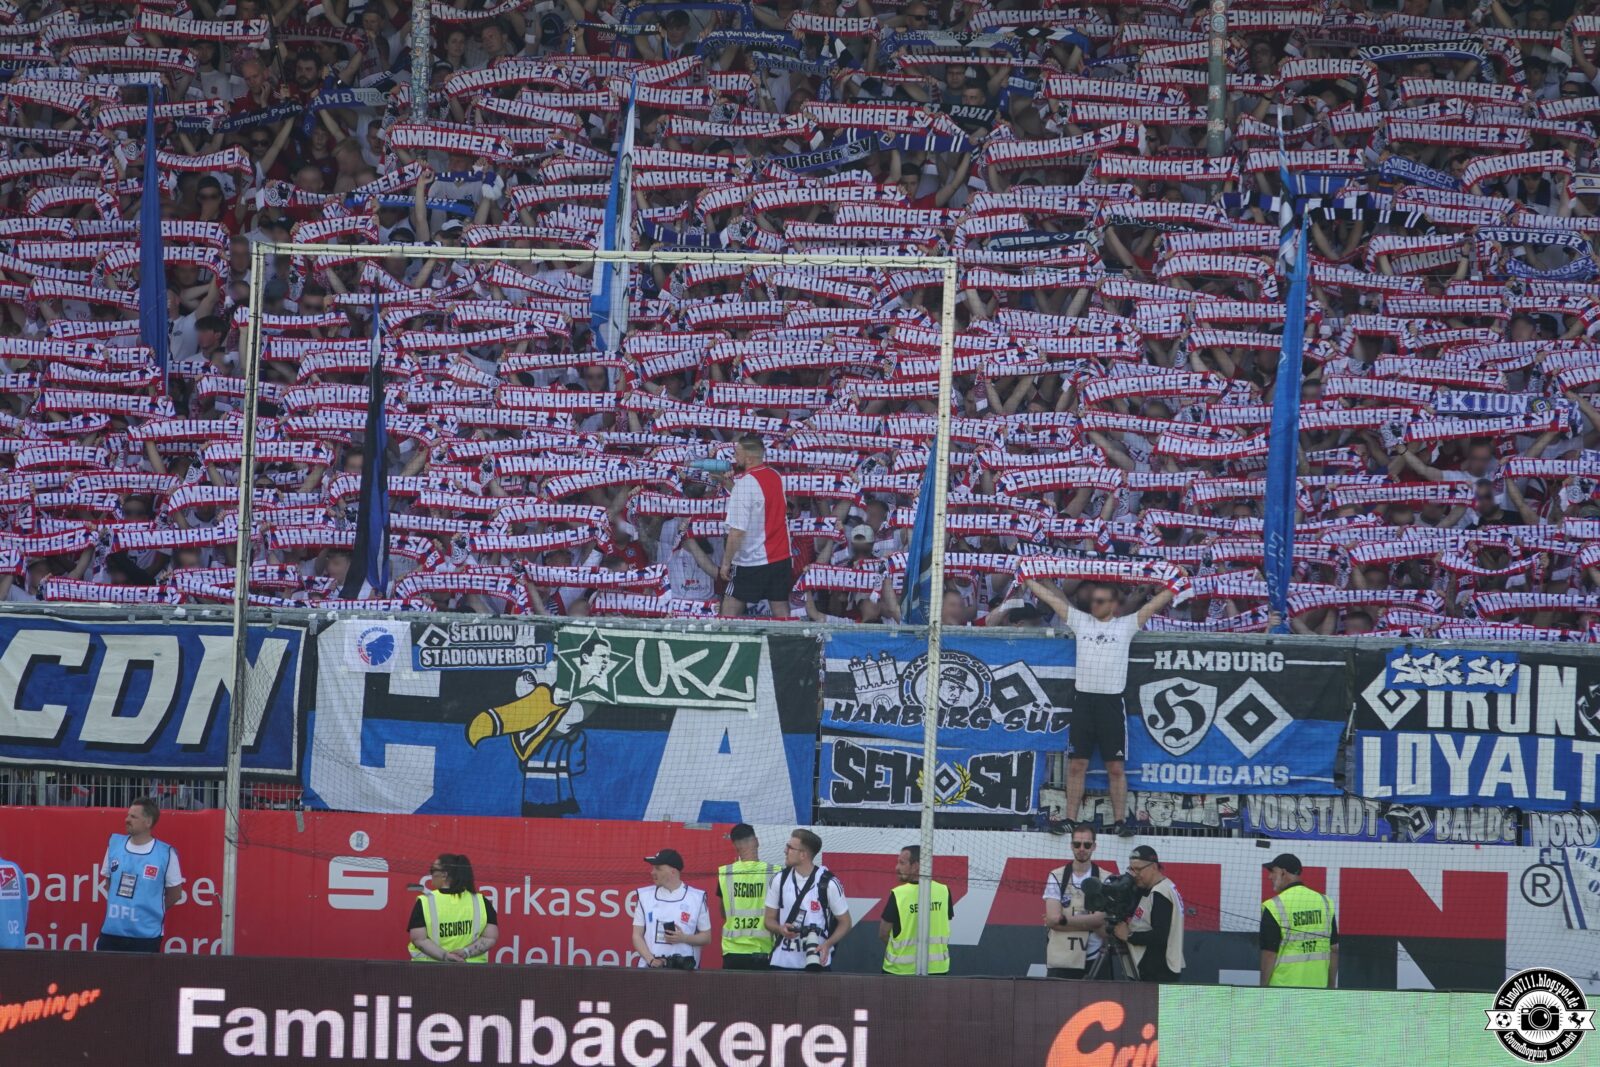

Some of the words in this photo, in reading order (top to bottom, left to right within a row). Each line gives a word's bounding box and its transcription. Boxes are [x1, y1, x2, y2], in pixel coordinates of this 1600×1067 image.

[1283, 57, 1371, 80] AMBURGER
[0, 155, 107, 175] AMBURGER
[632, 151, 728, 170] AMBURGER
[636, 172, 727, 186] MBURGER
[1383, 158, 1455, 185] AMBURGER
[513, 184, 611, 208] HAMBURGE
[974, 193, 1080, 212] AMBURGER
[1480, 231, 1583, 247] MBURGER
[688, 301, 783, 323] HAMBURG
[1, 339, 86, 357] MBURGER
[1191, 331, 1283, 346] HAMBURG
[1437, 392, 1527, 413] EKTION
[129, 420, 244, 439] HAMBURGE
[18, 447, 108, 465] MBURGER
[1510, 460, 1600, 474] HAMBURG
[640, 496, 727, 513] HAMBURG
[390, 514, 482, 532] MBURGER
[451, 622, 514, 643] SEKTION
[421, 646, 545, 667] STADIONVERBOT
[1154, 650, 1285, 672] HAMBURG
[831, 702, 994, 731] HAMBRG
[1141, 763, 1290, 786] HOOLIGANS
[1247, 795, 1382, 838] VORSTADT
[1529, 810, 1600, 848] NORD
[733, 881, 764, 898] SECURITY
[108, 903, 140, 922] DFL
[1292, 909, 1322, 927] SECURITY
[439, 919, 473, 938] SECURITY
[177, 986, 869, 1067] Familienbäckerei
